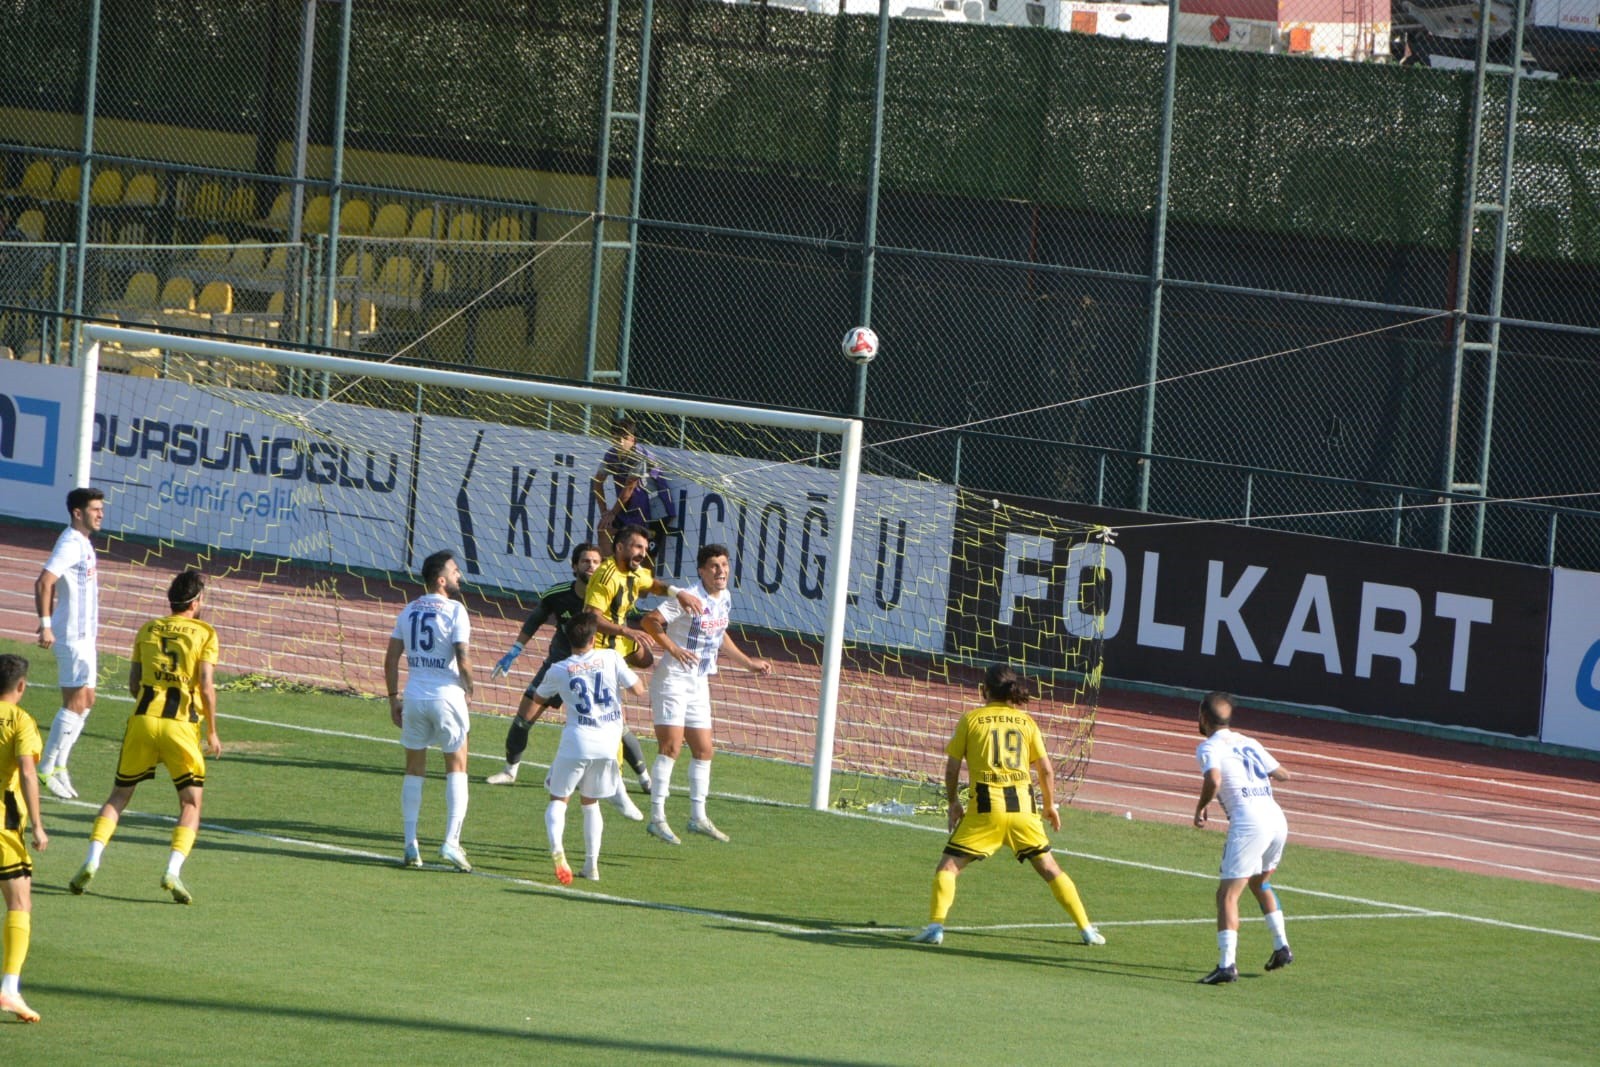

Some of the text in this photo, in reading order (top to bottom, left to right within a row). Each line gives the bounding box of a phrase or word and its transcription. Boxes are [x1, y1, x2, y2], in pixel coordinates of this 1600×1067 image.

[157, 476, 300, 523] demir çelik
[147, 624, 197, 635] ESTENET
[408, 611, 435, 652] 15
[998, 532, 1494, 693] FOLKART
[161, 636, 178, 673] 5
[569, 671, 613, 714] 34
[977, 715, 1026, 726] ESTENET
[991, 728, 1022, 769] 19
